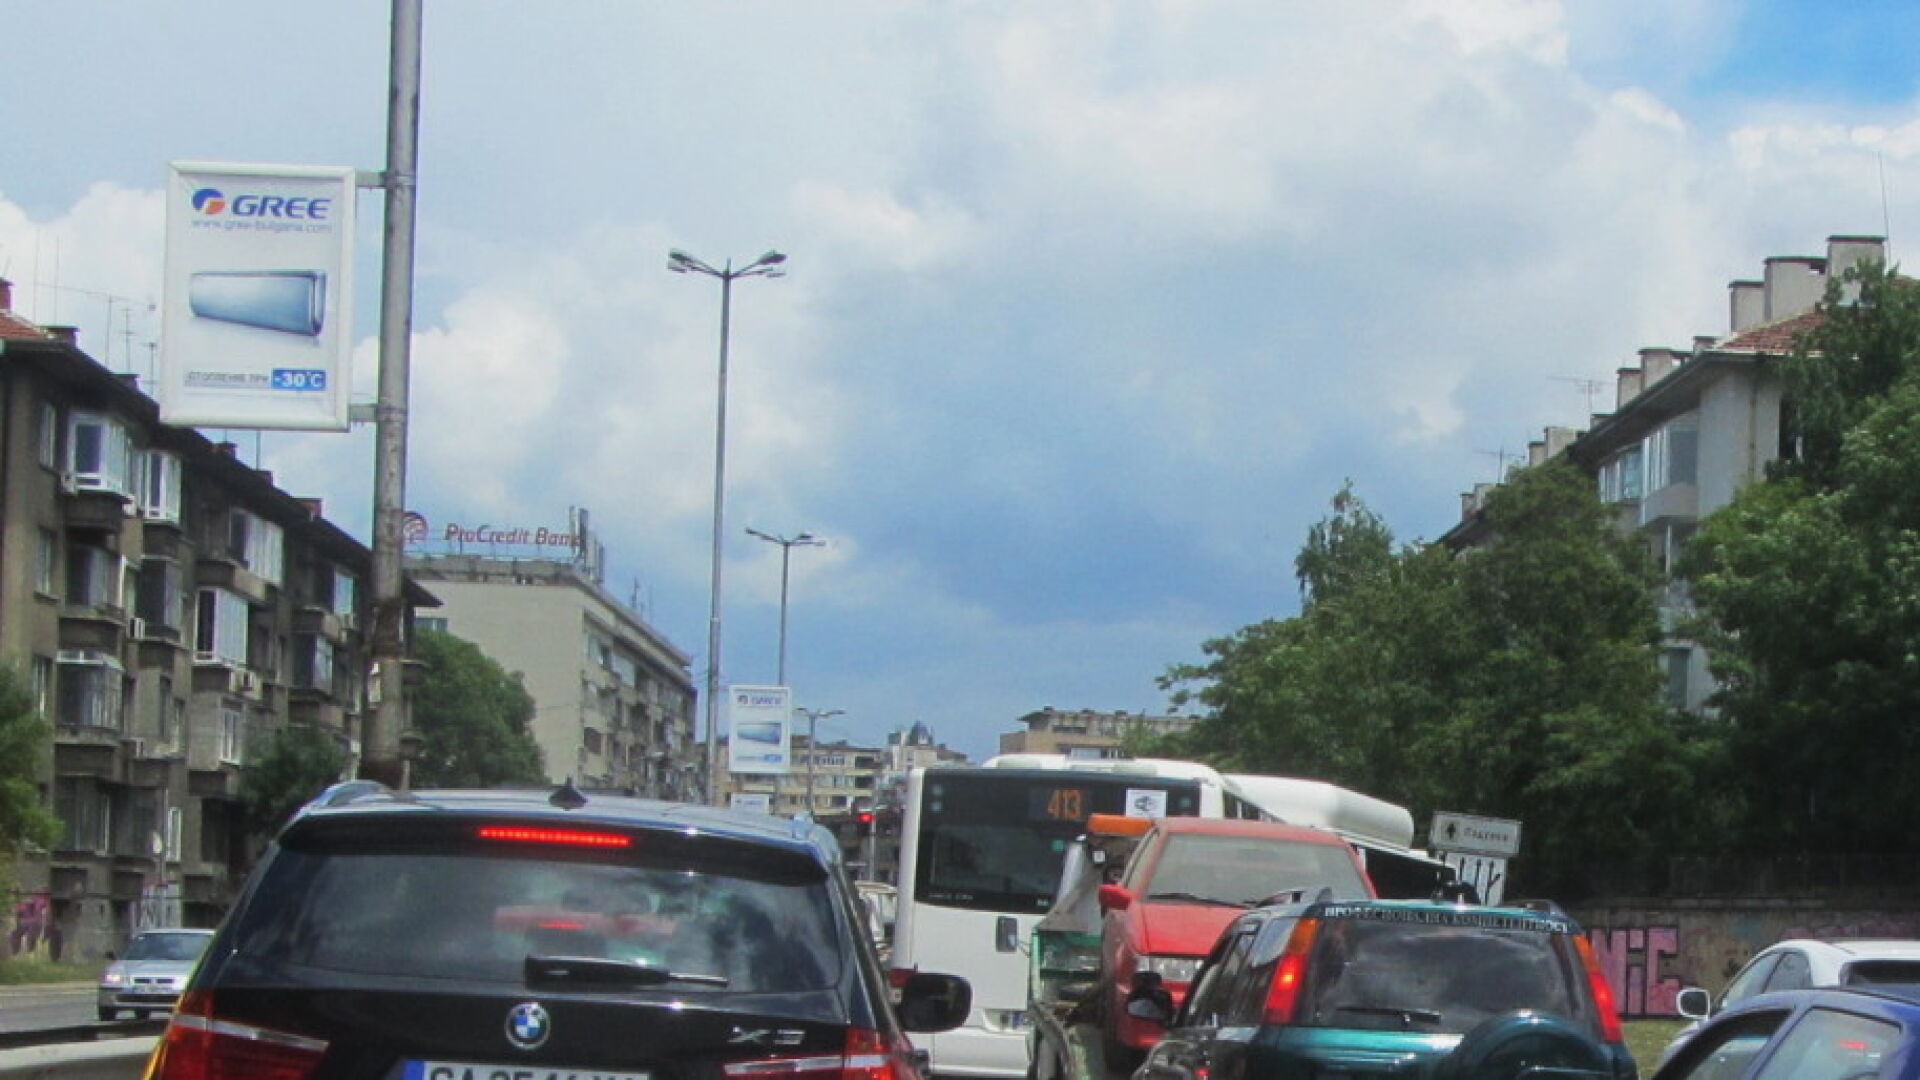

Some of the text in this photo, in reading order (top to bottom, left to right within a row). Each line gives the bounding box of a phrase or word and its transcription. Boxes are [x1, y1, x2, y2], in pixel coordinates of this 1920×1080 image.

[231, 194, 332, 219] GREE
[444, 522, 529, 545] ProCredit
[1047, 788, 1081, 820] 413
